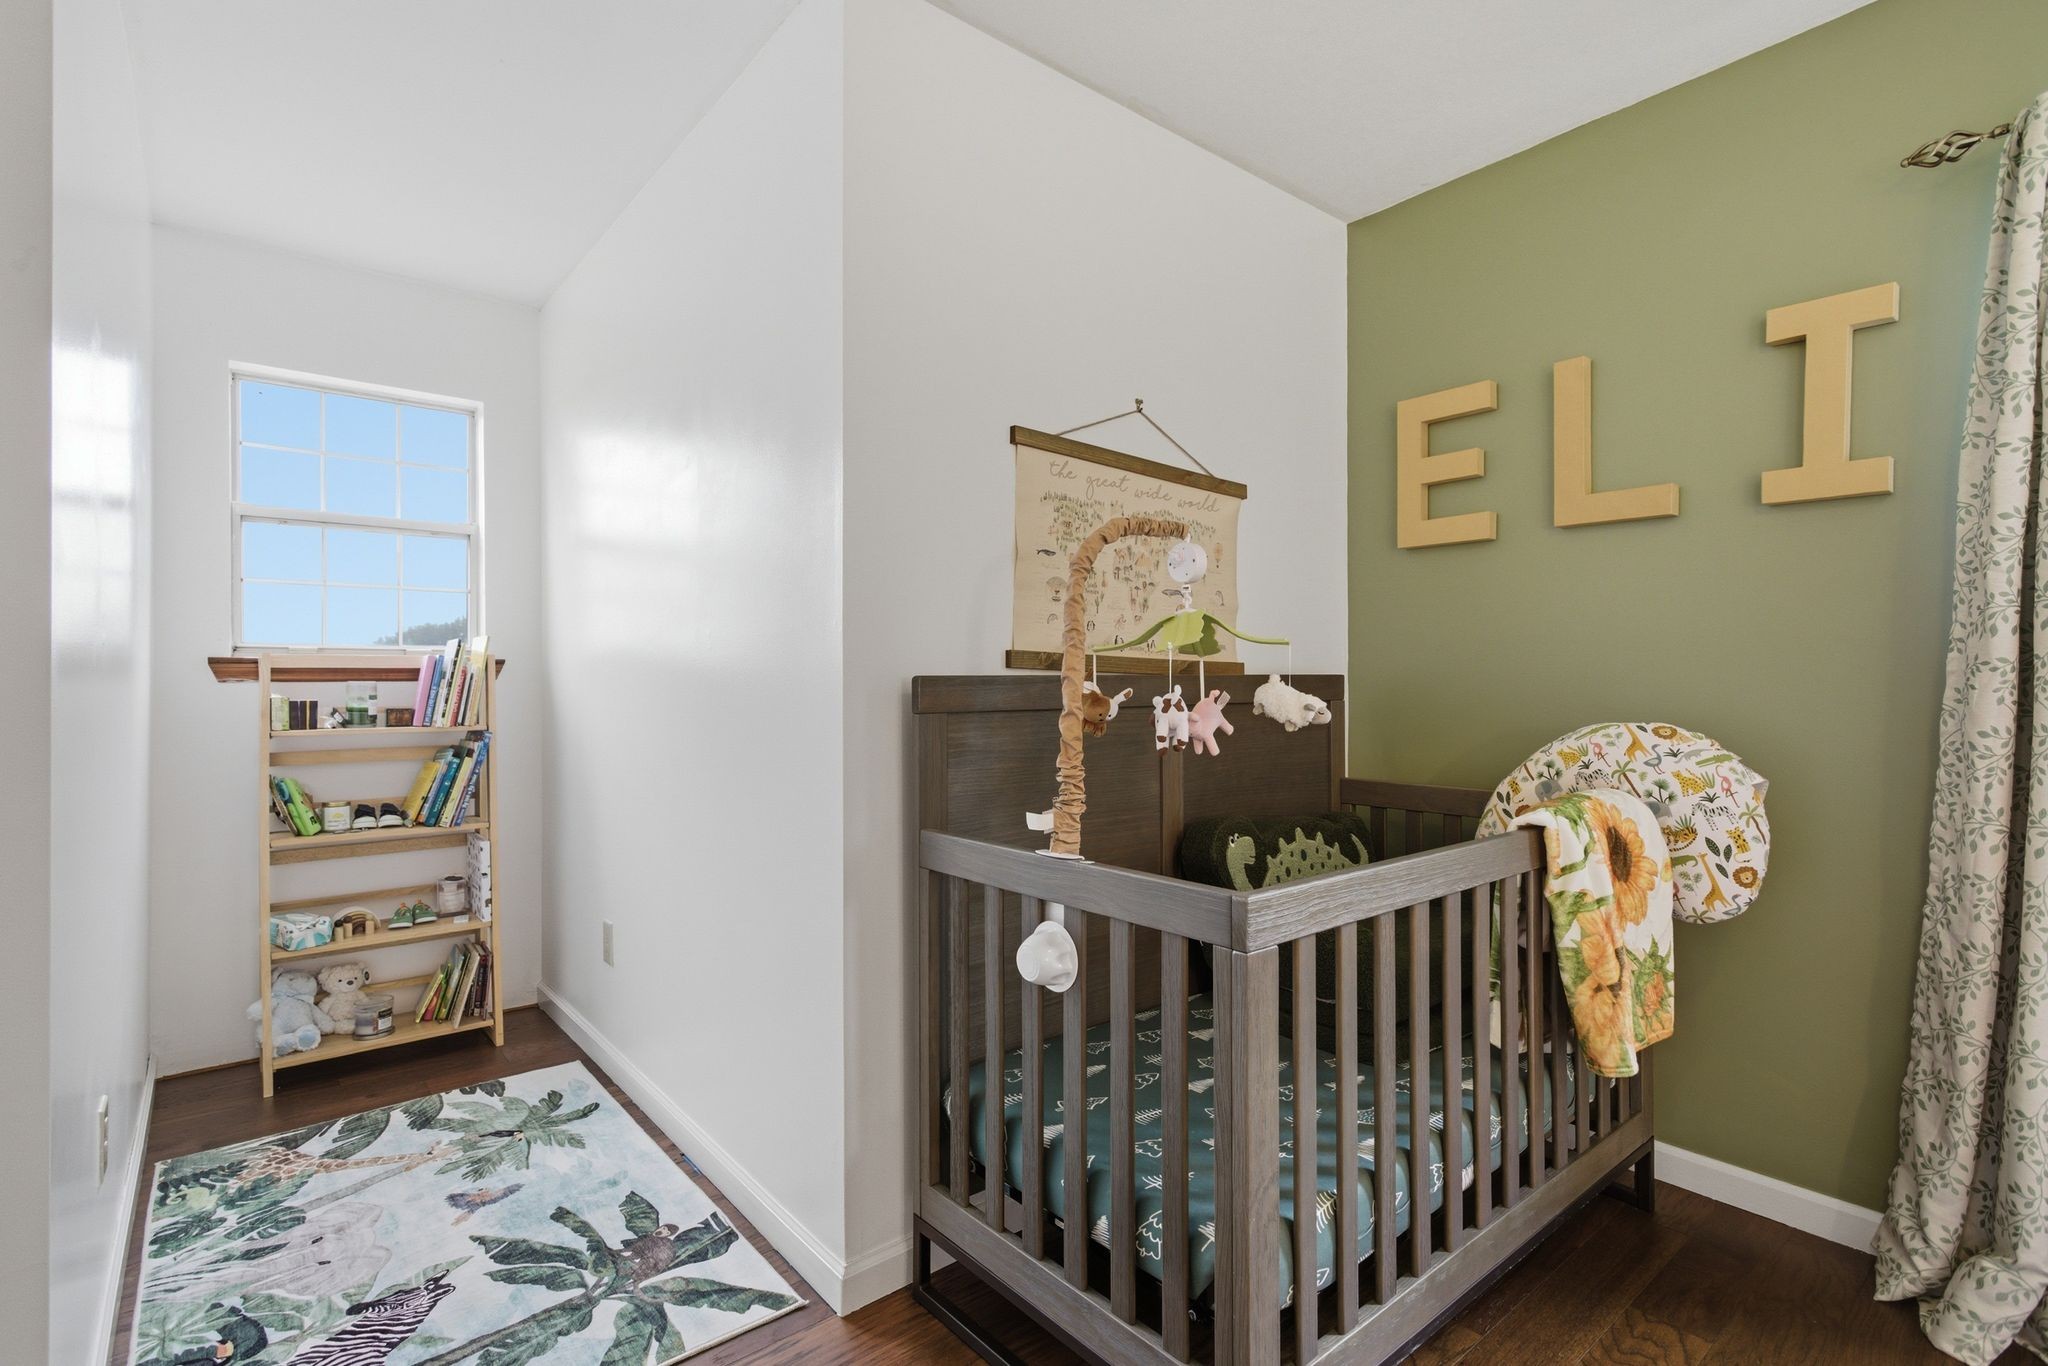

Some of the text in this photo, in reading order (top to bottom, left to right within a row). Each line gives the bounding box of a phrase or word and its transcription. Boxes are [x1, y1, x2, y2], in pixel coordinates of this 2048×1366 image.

[1049, 460, 1220, 513] the great wide world
[1397, 281, 1900, 550] ELI
